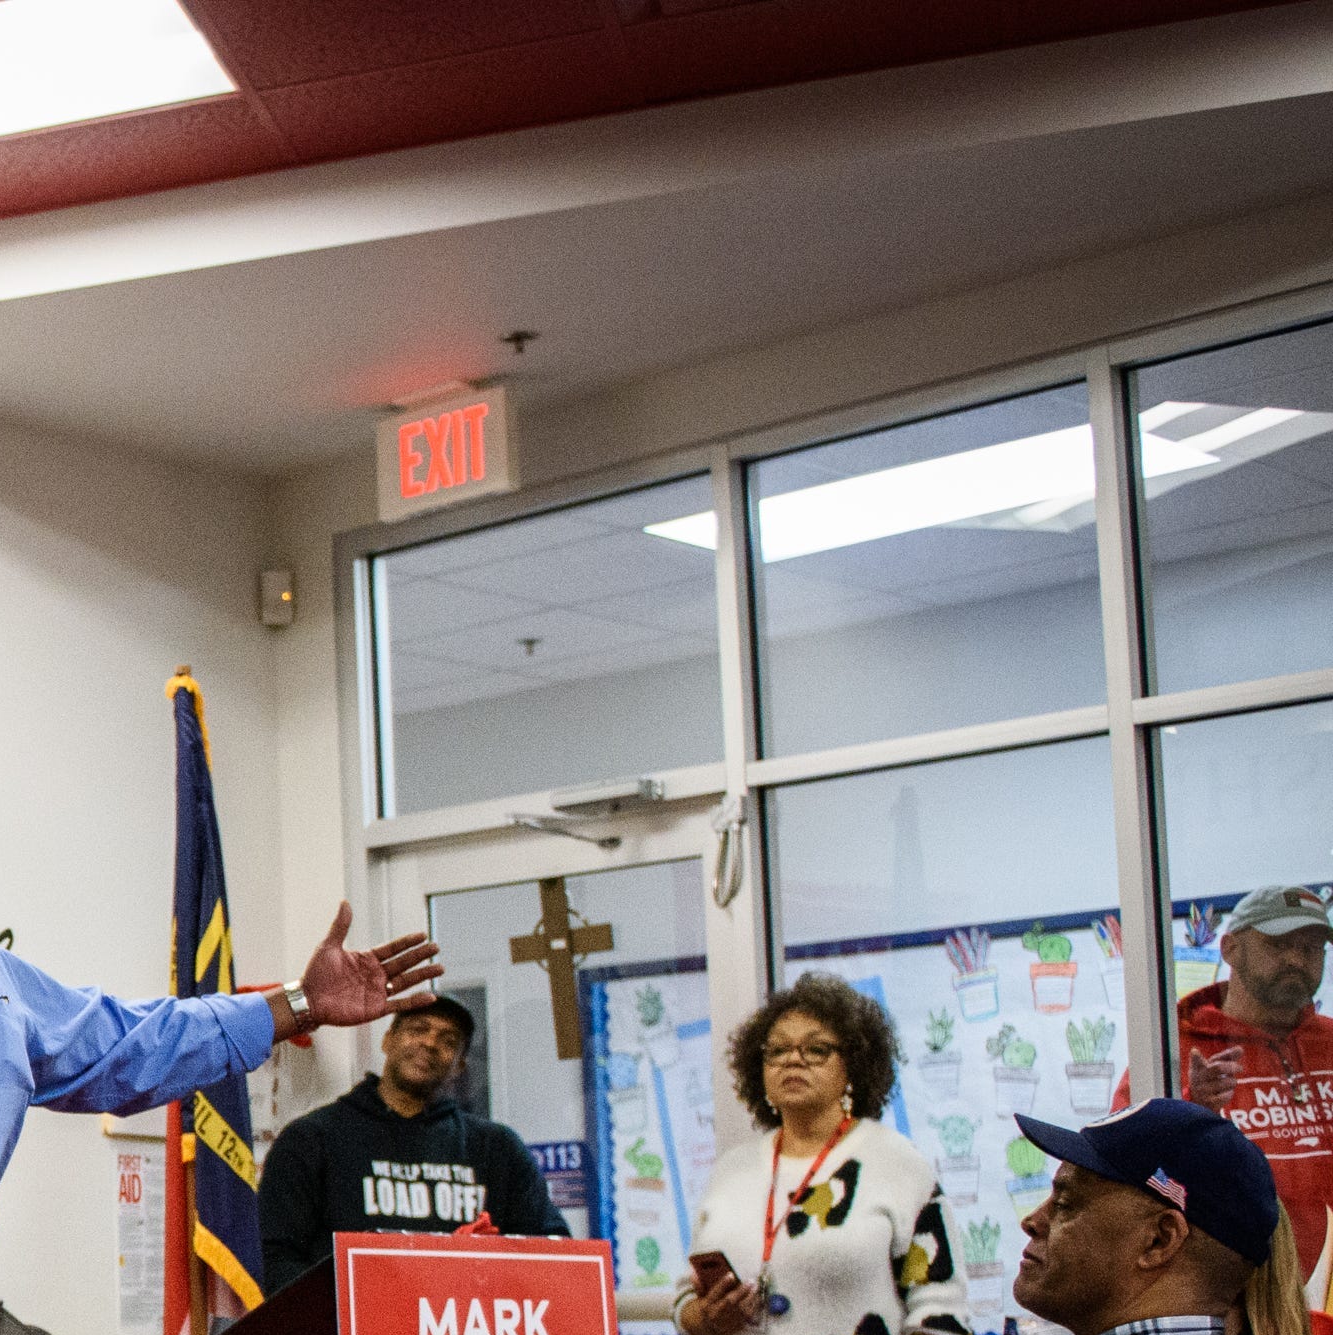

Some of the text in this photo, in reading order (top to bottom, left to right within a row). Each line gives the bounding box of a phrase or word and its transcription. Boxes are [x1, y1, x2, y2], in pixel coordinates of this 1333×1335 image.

[398, 402, 489, 498] EXIT
[118, 1174, 142, 1203] AID
[363, 1176, 431, 1218] LOAD
